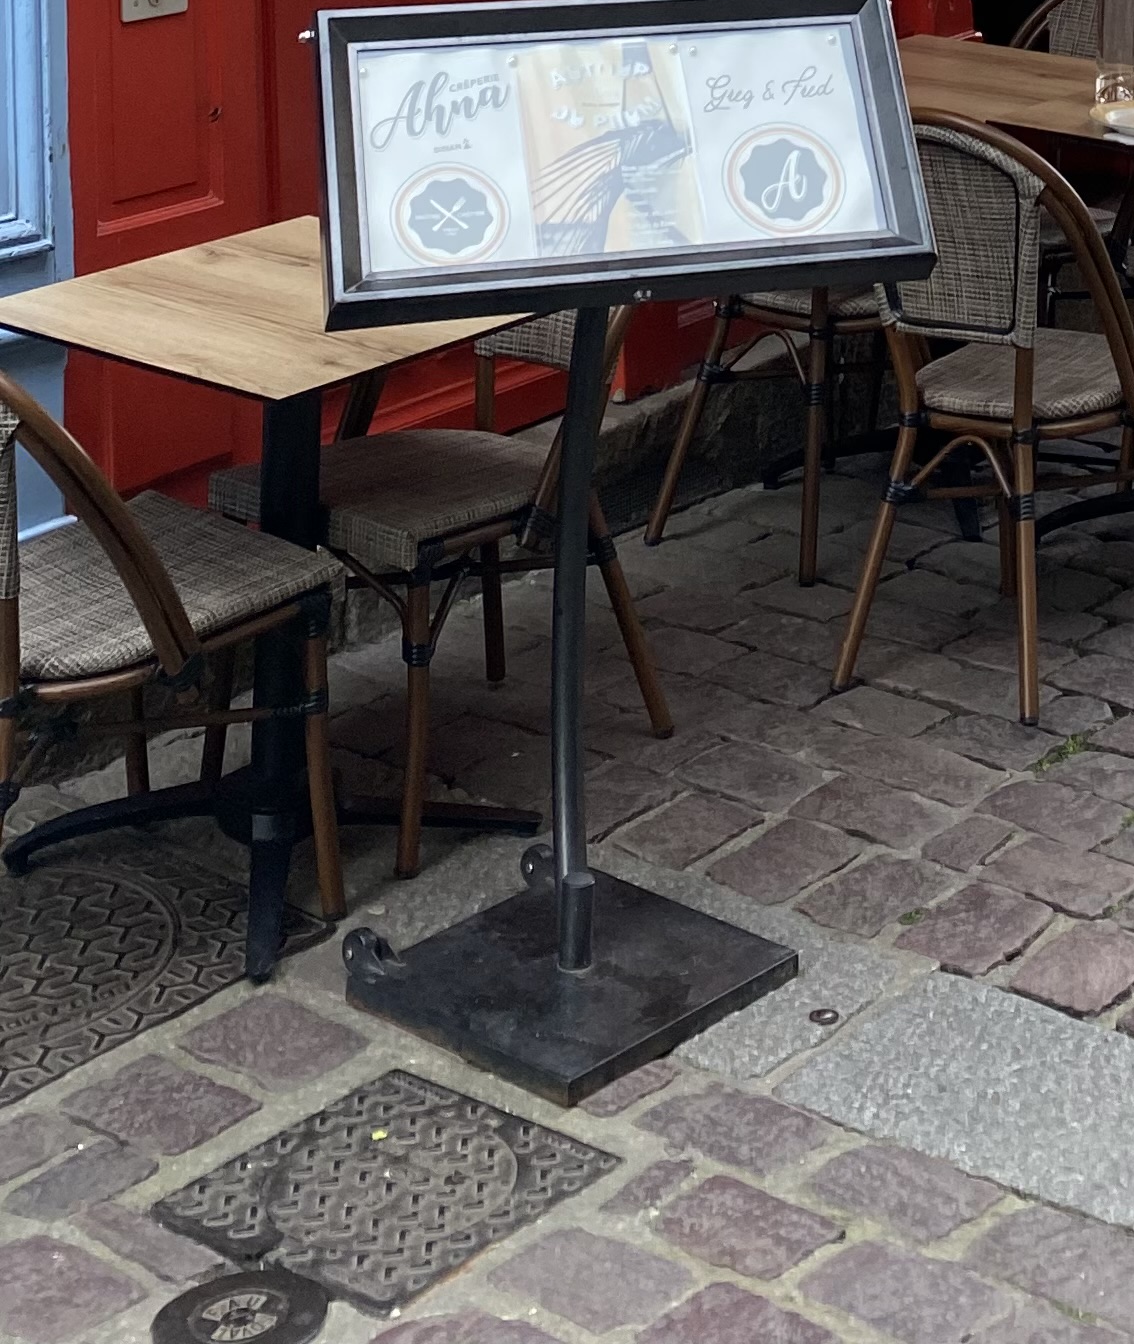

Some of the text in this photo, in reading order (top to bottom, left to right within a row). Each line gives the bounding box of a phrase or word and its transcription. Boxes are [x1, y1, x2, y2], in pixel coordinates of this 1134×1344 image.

[704, 74, 755, 113] Greg
[762, 80, 776, 101] &
[781, 66, 835, 106] Fred
